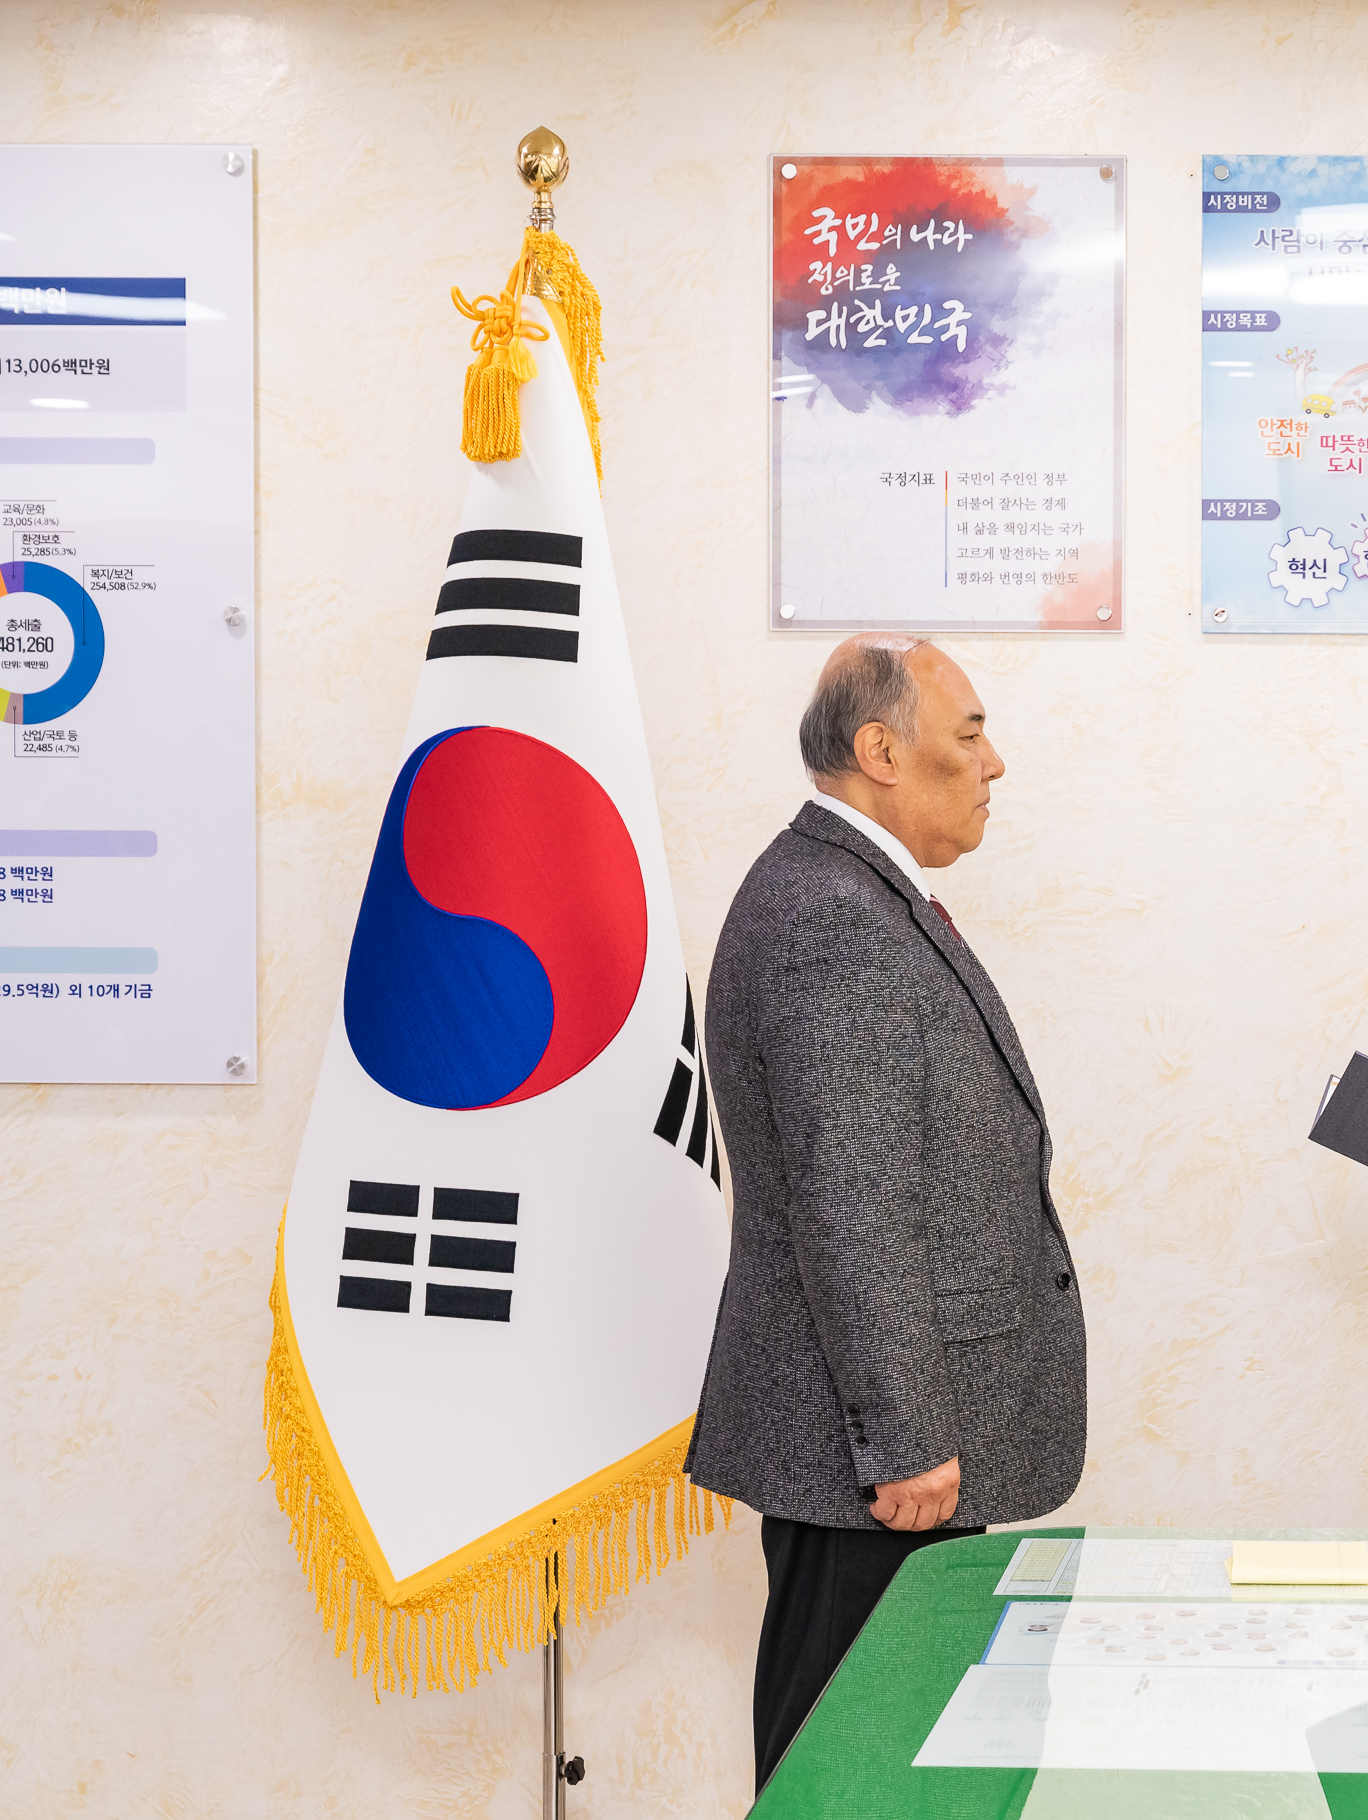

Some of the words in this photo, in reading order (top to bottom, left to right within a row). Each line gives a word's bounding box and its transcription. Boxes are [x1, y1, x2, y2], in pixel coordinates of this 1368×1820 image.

[1208, 194, 1268, 210] 시정비전
[804, 207, 902, 257] 국민의
[909, 219, 973, 252] 나라
[1254, 228, 1324, 254] 사람이
[807, 261, 901, 295] 정의로운
[804, 299, 973, 353] 대한민국
[1208, 313, 1268, 328] 시정목표
[1258, 419, 1310, 439] 안전한
[1265, 441, 1301, 458] 도시
[1327, 457, 1363, 474] 도시
[879, 471, 935, 487] 국정지표
[956, 472, 995, 486] 국민이
[999, 472, 1038, 486] 주인인
[1043, 472, 1068, 486] 정부
[2, 504, 46, 515] 교육/문화
[957, 497, 994, 511] 더불어
[999, 497, 1037, 511] 잘사는
[1042, 497, 1066, 511] 경제
[1208, 502, 1268, 517] 시정기조
[956, 522, 968, 535] 내
[973, 522, 999, 536] 삶을
[1003, 522, 1054, 536] 책임지는
[1058, 522, 1084, 535] 국가
[21, 534, 61, 545] 환경보호
[956, 547, 994, 560] 고르게
[999, 547, 1050, 560] 발전하는
[1055, 547, 1079, 560] 지역
[90, 569, 133, 580] 복지/보건
[1288, 558, 1328, 580] 혁신
[956, 572, 994, 585] 평화와
[999, 572, 1036, 585] 번영의
[1041, 572, 1079, 585] 한반도
[6, 618, 42, 632] 총세출
[22, 730, 66, 742] 산업/국토
[67, 730, 78, 742] 등
[23, 743, 53, 754] 22,485
[10, 866, 54, 882] 백만원
[10, 888, 54, 904] 백만원
[0, 983, 60, 999] 9.5억원)
[68, 983, 82, 998] 외
[88, 983, 120, 999] 10개
[124, 984, 153, 999] 기금
